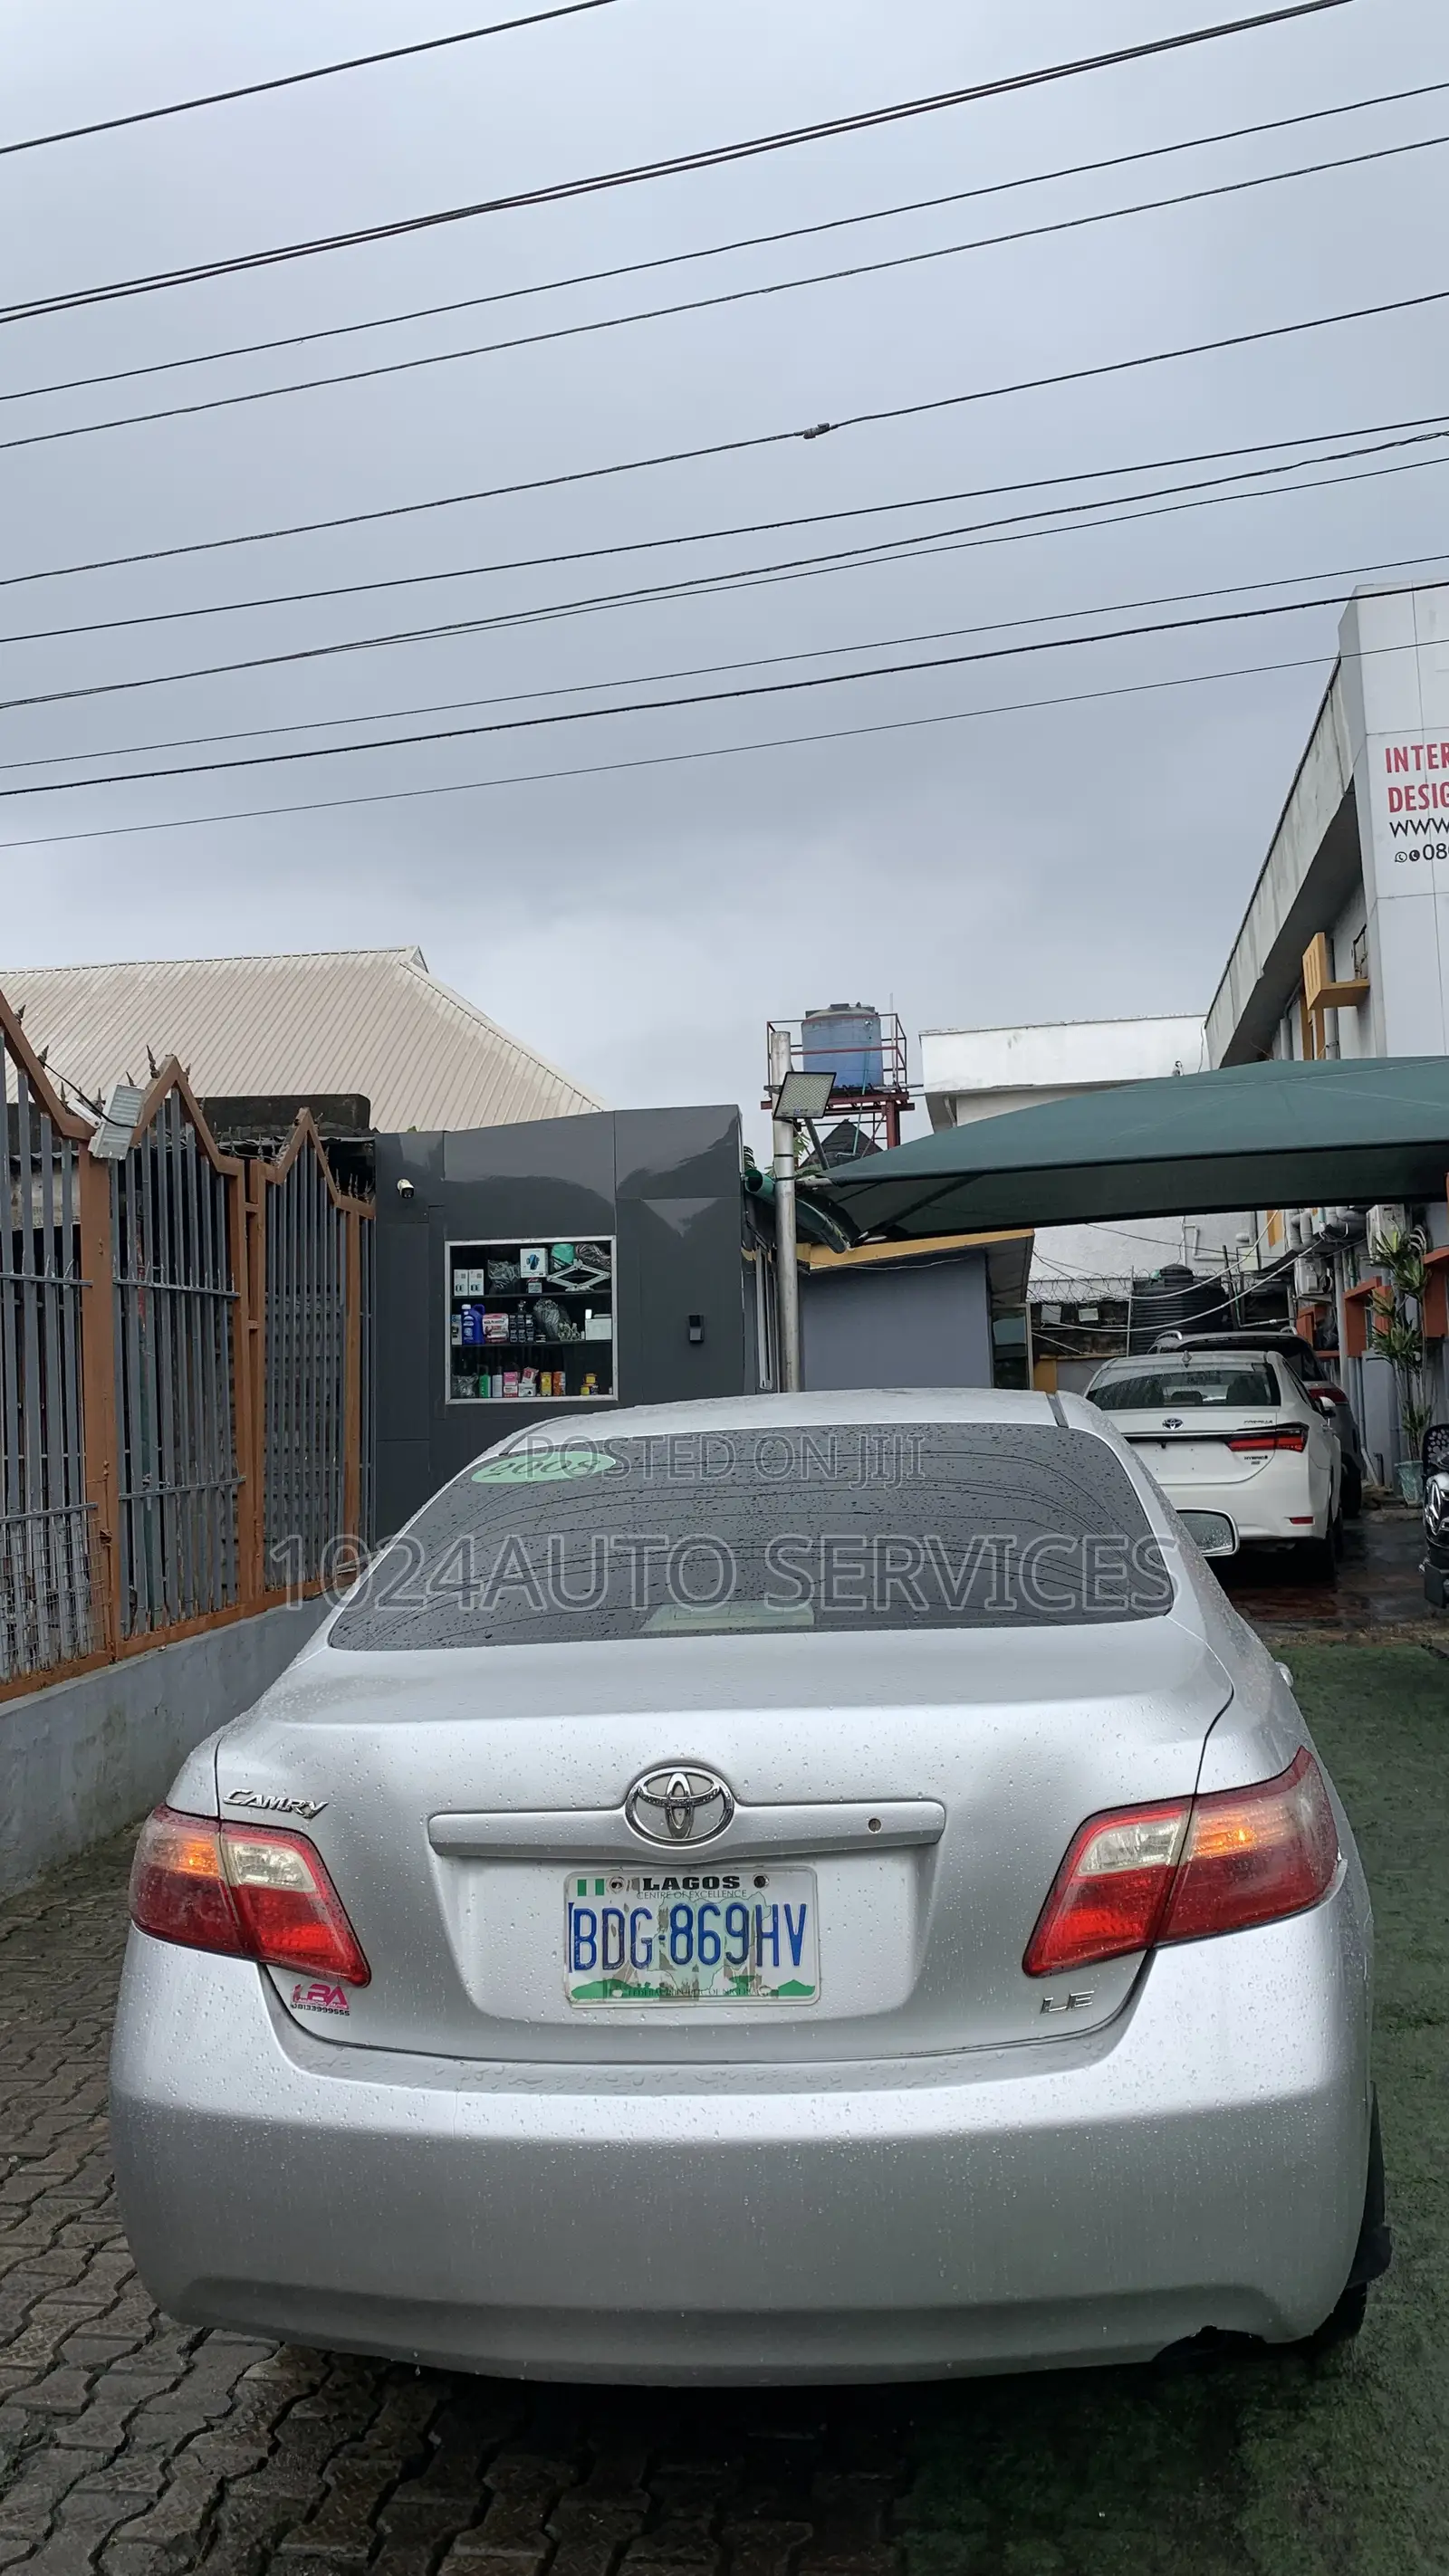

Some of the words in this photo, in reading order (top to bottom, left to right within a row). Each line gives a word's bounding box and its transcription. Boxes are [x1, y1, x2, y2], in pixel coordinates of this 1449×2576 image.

[1387, 781, 1449, 813] DESIG
[1423, 843, 1449, 860] 08
[223, 1789, 329, 1819] CAMRY
[642, 1875, 741, 1891] LAGOS
[637, 1891, 670, 1900] CENTRE
[674, 1891, 685, 1900] OF
[689, 1889, 747, 1899] EXCELLENCE
[1040, 1990, 1095, 2015] LE
